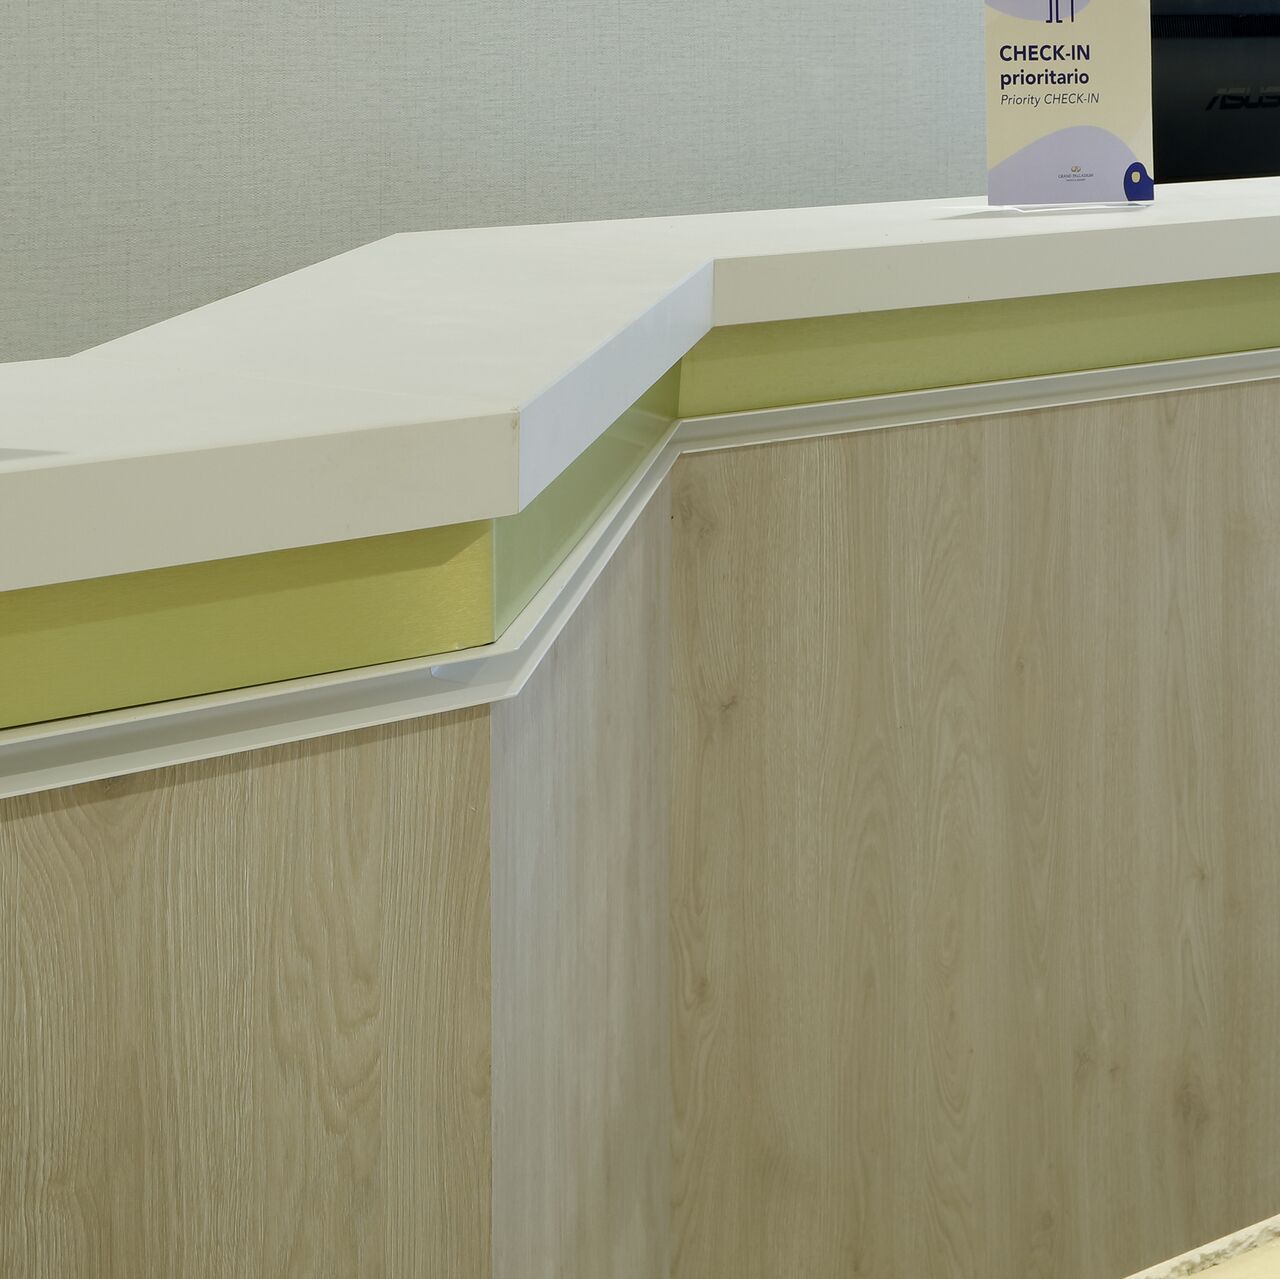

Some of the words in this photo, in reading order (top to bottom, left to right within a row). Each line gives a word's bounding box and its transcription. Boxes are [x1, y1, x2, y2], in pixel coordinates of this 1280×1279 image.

[999, 44, 1091, 62] CHECK-IN
[1000, 69, 1090, 90] prioritario
[1000, 94, 1041, 107] Priority
[1044, 93, 1100, 104] CHECK-IN
